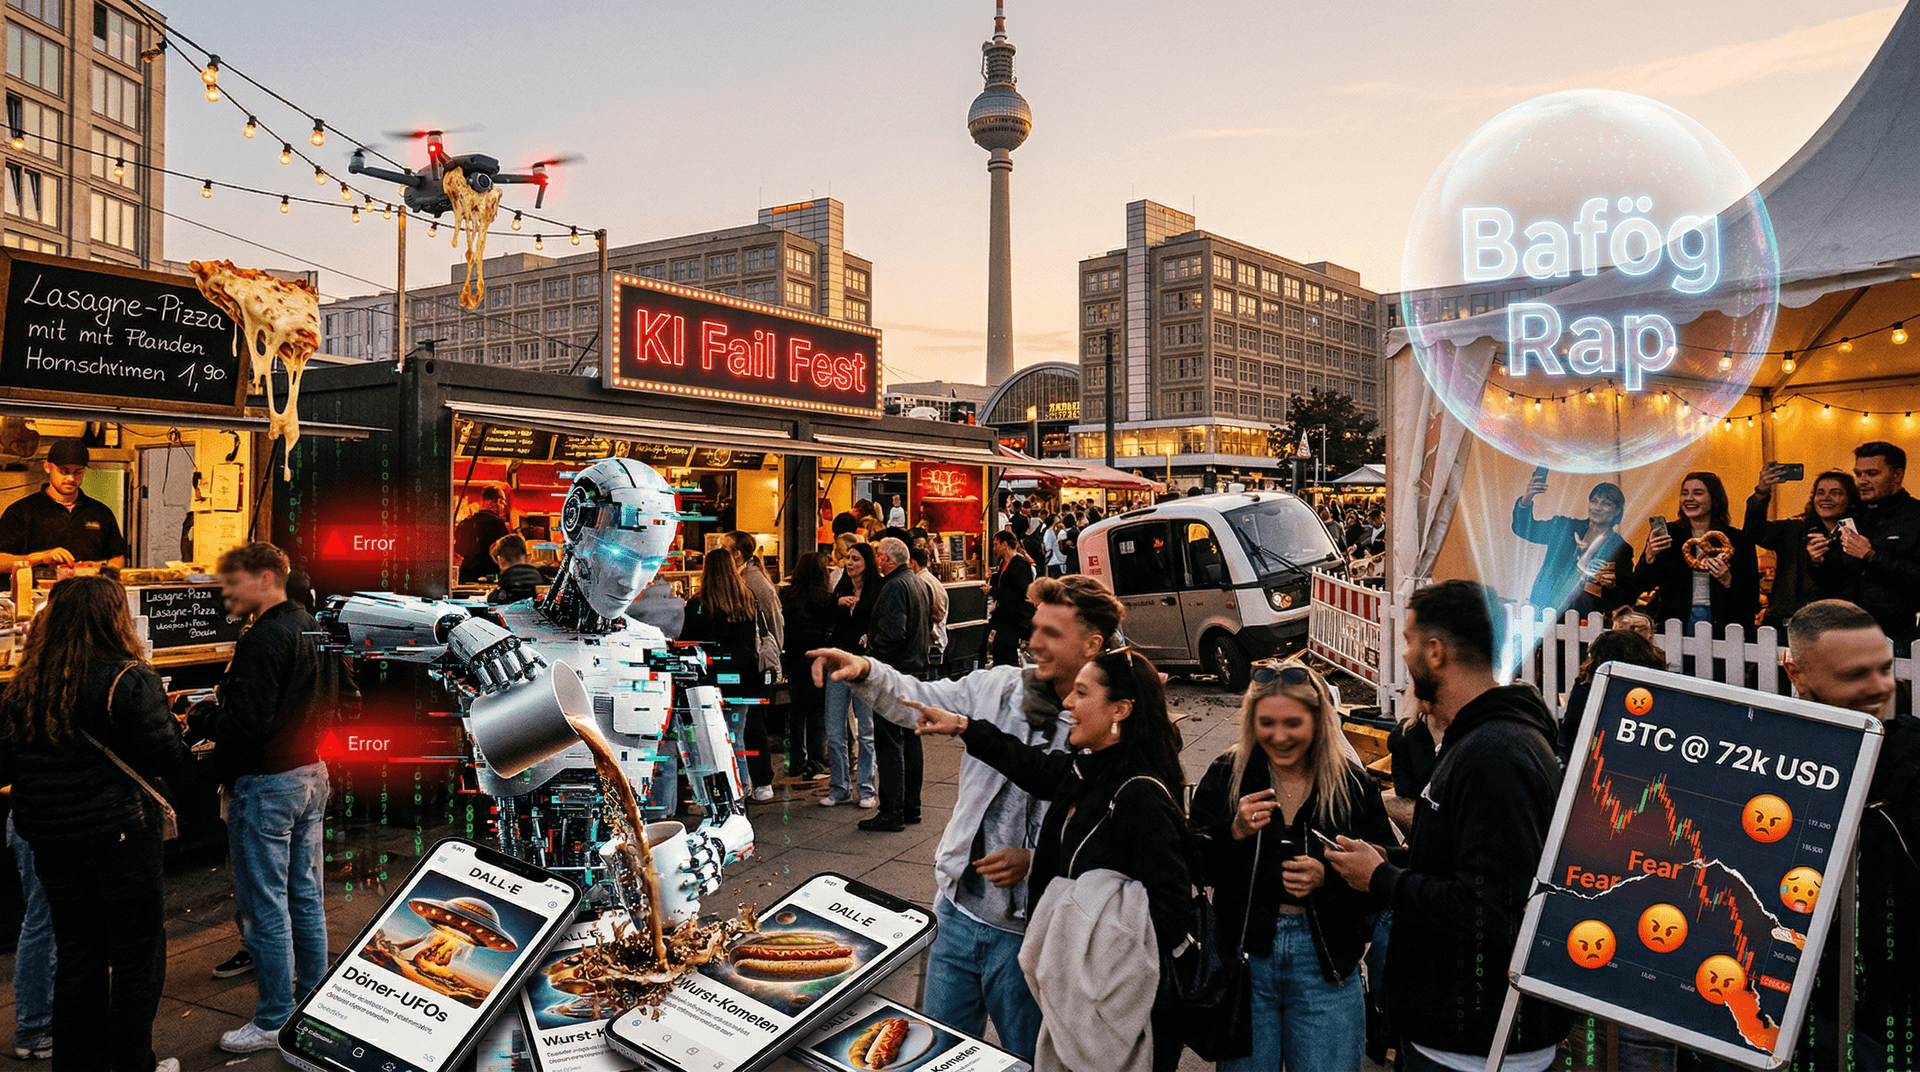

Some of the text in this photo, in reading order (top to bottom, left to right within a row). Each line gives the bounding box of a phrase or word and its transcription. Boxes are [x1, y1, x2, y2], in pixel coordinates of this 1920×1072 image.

[1460, 195, 1722, 294] Bafög
[24, 274, 226, 332] Lasagne-Pizza
[28, 319, 206, 356] mit mit Flanden
[636, 308, 867, 393] KI Fail Fest
[1506, 302, 1677, 391] Rap
[26, 346, 166, 383] Hornschrimen
[353, 535, 396, 551] Error
[347, 735, 391, 751] Error
[1615, 716, 1841, 792] BTC @ 72k USD
[1566, 864, 1622, 892] Fear
[1628, 850, 1684, 881] Fear
[341, 966, 449, 1022] Döner-UFOs
